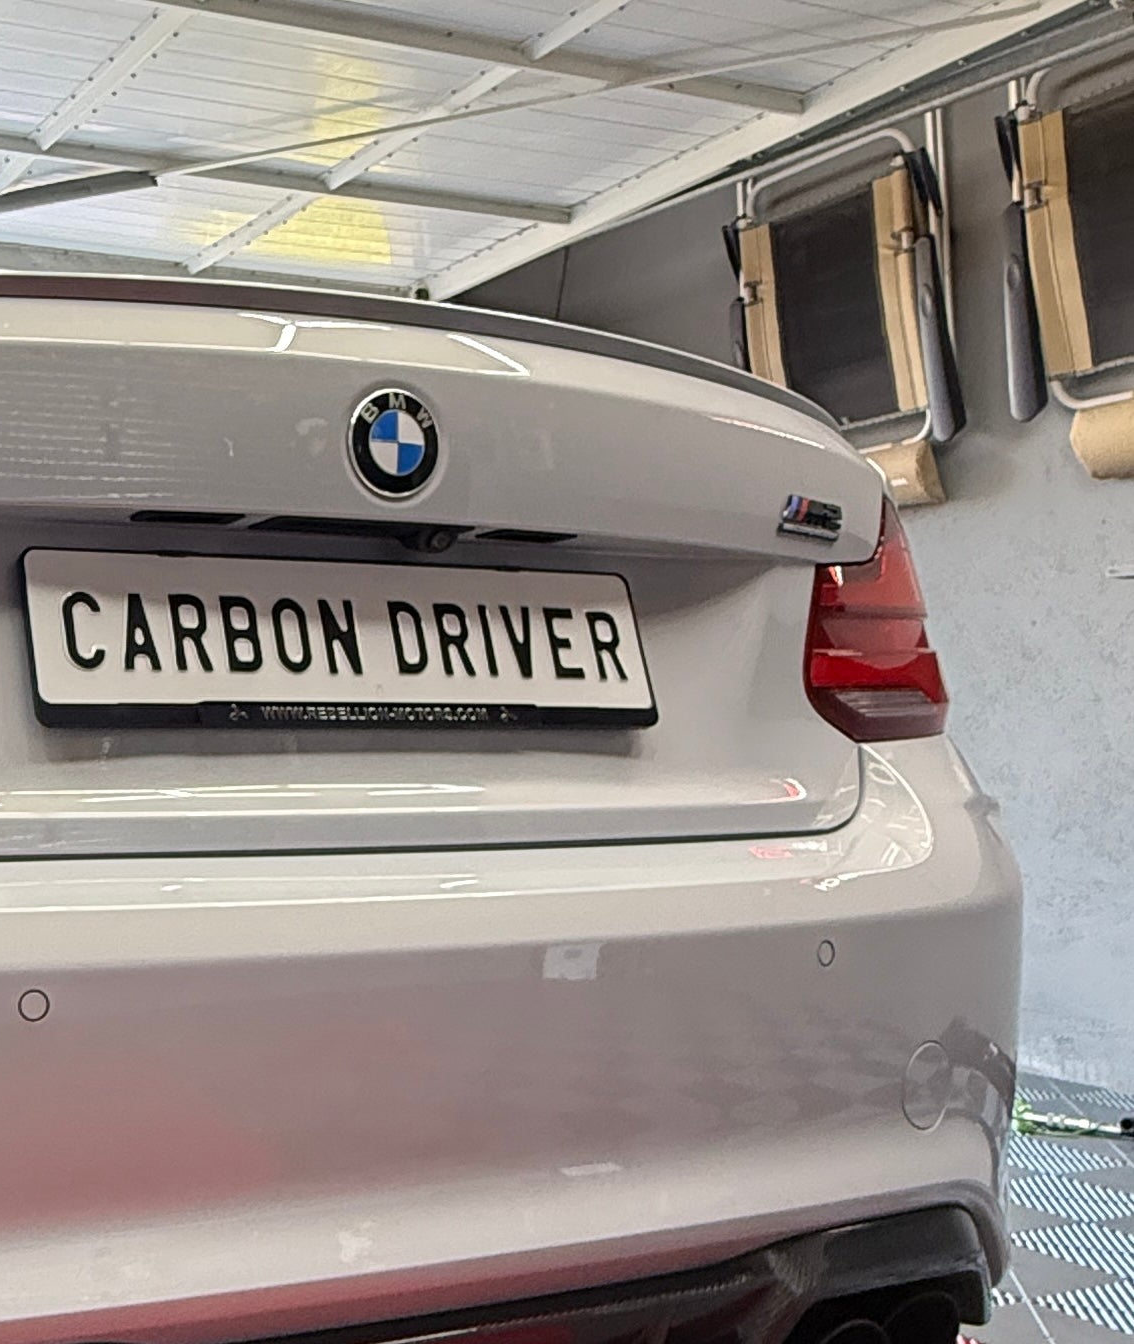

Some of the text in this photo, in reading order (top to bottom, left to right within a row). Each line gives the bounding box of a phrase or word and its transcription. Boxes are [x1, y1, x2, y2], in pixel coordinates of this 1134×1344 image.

[361, 392, 433, 428] BMW
[62, 592, 628, 681] CARBON DRIVER
